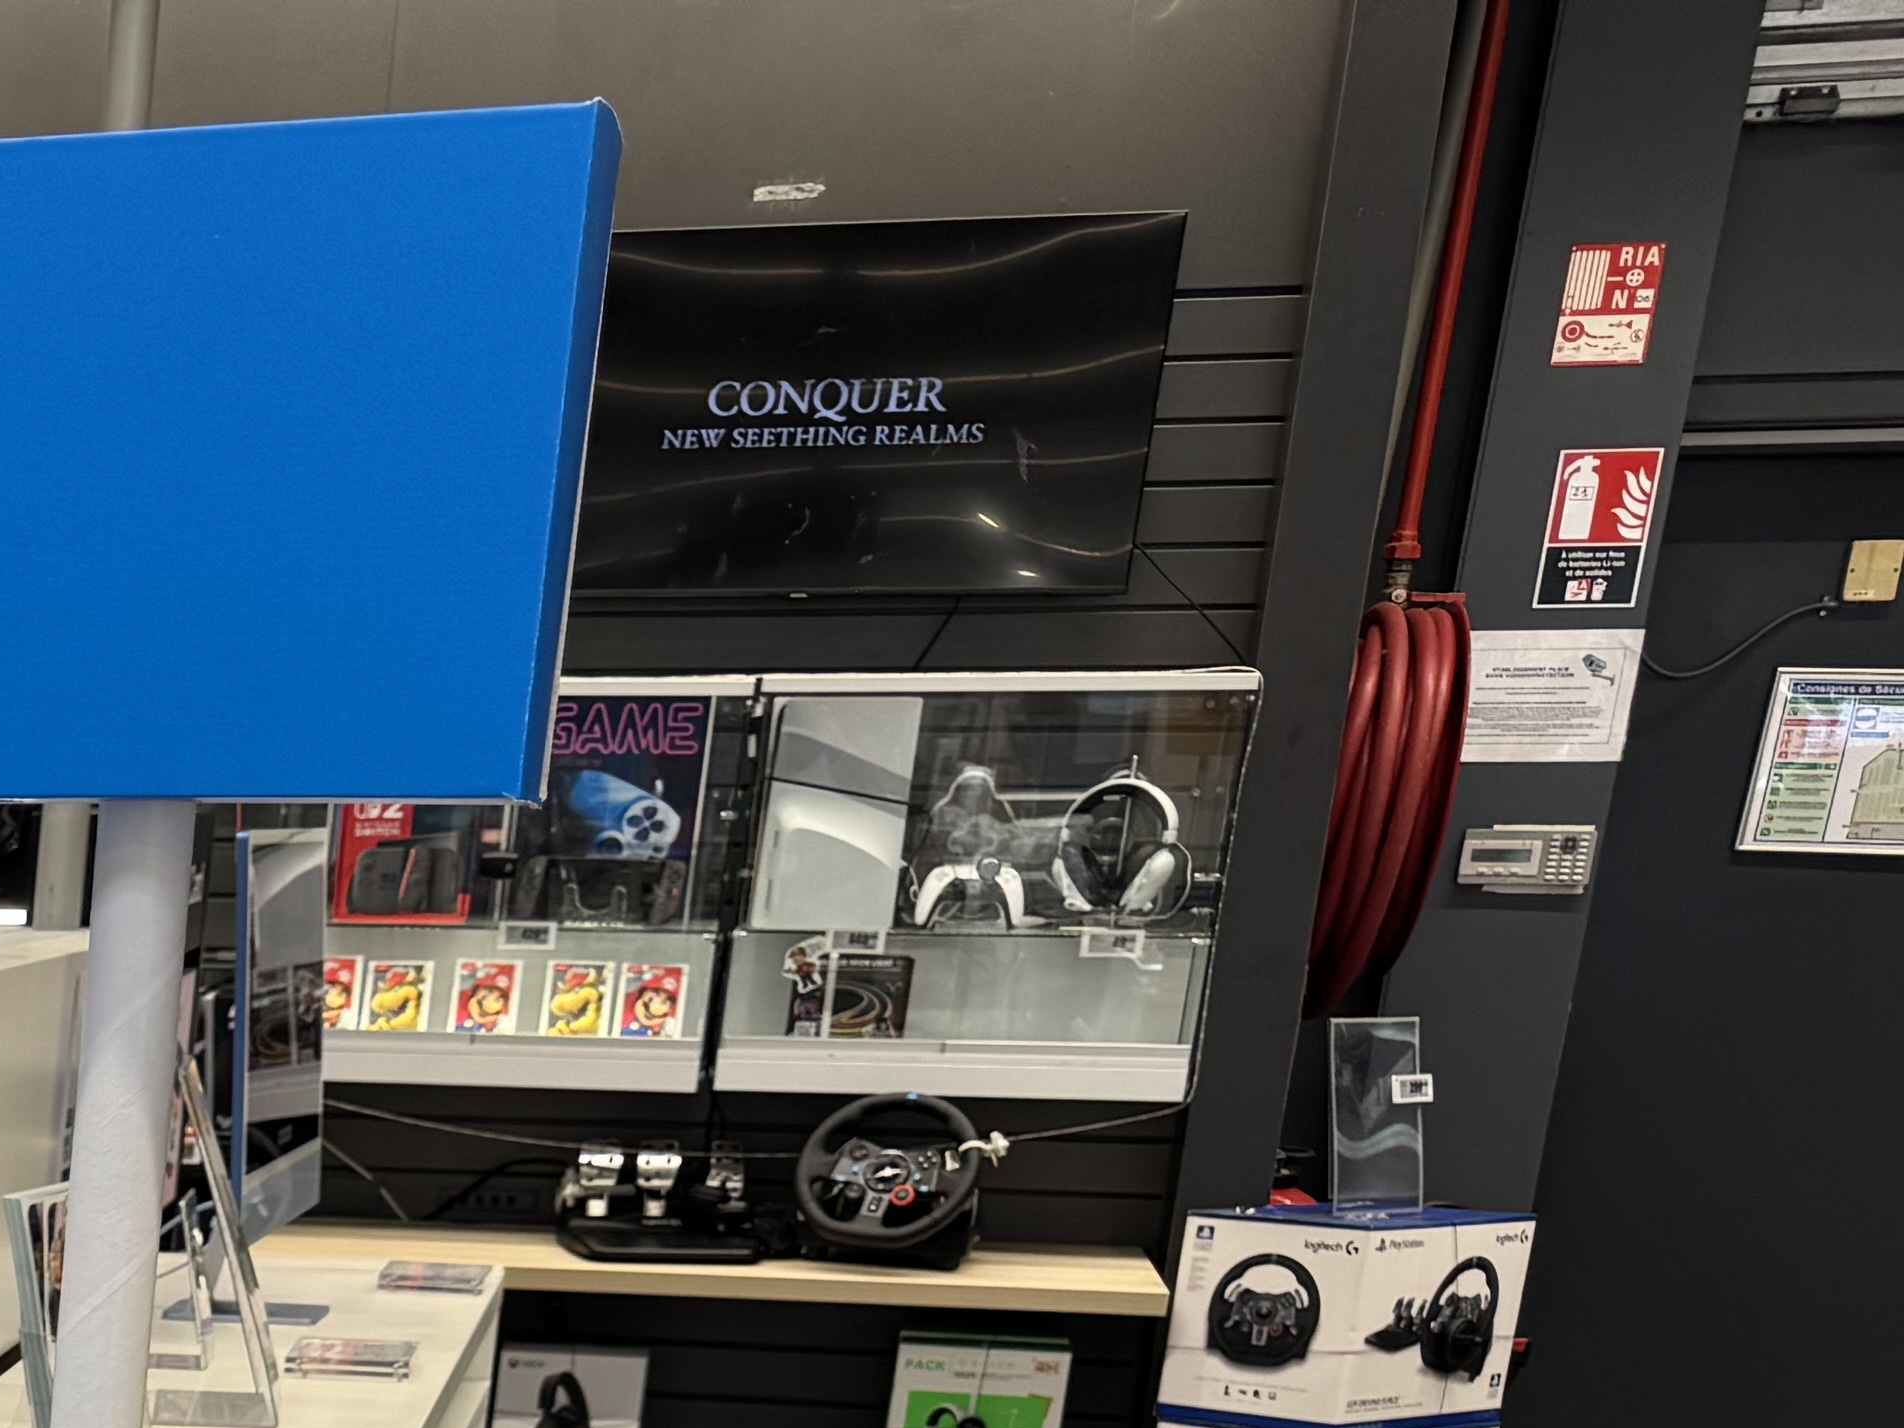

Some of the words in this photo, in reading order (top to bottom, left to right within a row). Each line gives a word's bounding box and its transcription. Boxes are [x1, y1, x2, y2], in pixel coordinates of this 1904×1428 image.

[1619, 245, 1661, 268] RIA
[707, 377, 948, 423] CONQUER
[661, 428, 727, 450] NEW
[730, 425, 868, 449] SEETHING
[873, 422, 988, 446] REALMS
[1796, 682, 1857, 696] Consignes
[1858, 685, 1872, 694] de
[551, 702, 705, 756] GAME
[904, 1359, 946, 1372] PACK
